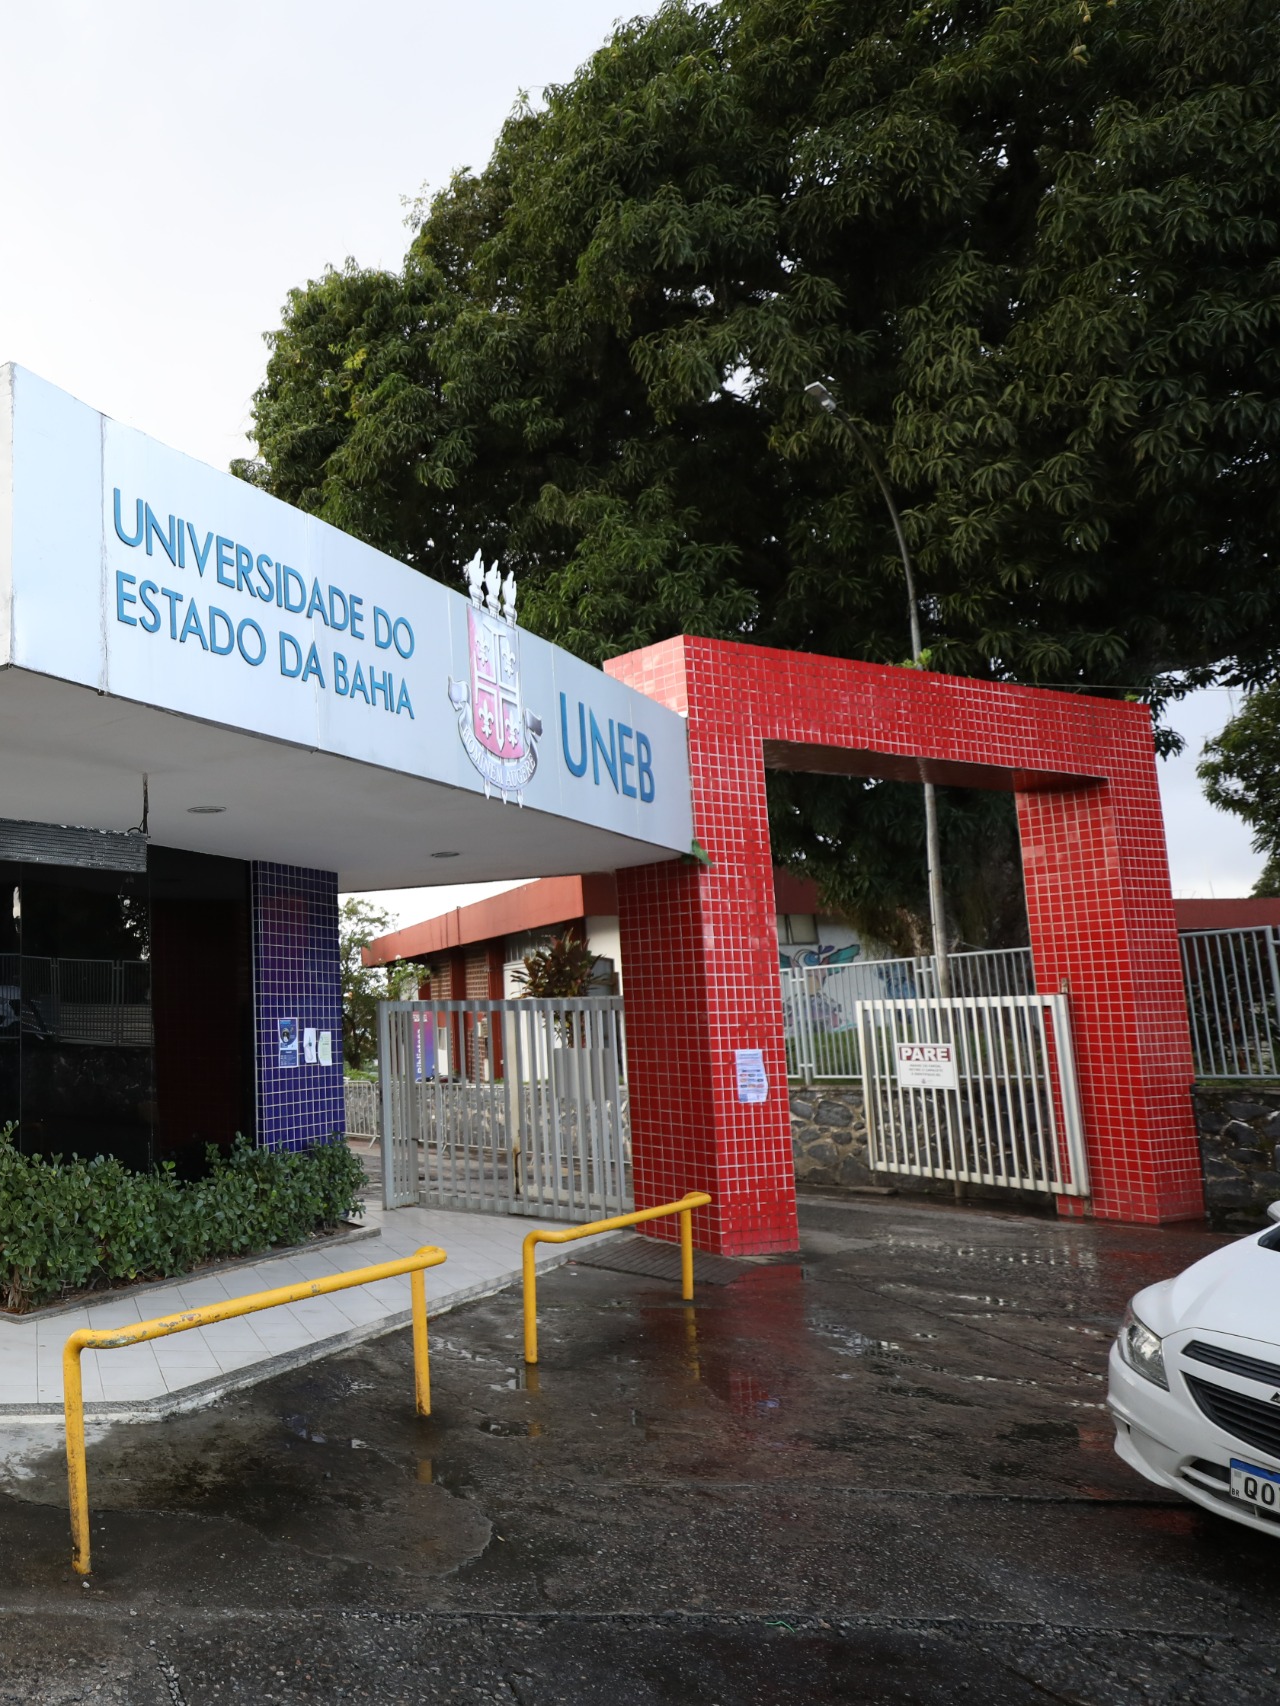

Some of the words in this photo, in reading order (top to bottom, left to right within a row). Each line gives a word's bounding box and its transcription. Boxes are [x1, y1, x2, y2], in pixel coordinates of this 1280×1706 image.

[113, 487, 365, 641] UNIVERSIDADE
[373, 606, 415, 659] DO
[116, 570, 267, 666] ESTADO
[279, 631, 326, 688] DA
[333, 652, 415, 720] BAHIA
[559, 691, 655, 803] UNEB
[901, 1048, 949, 1061] PARE
[1231, 1487, 1240, 1497] BR
[1244, 1477, 1280, 1506] QO
